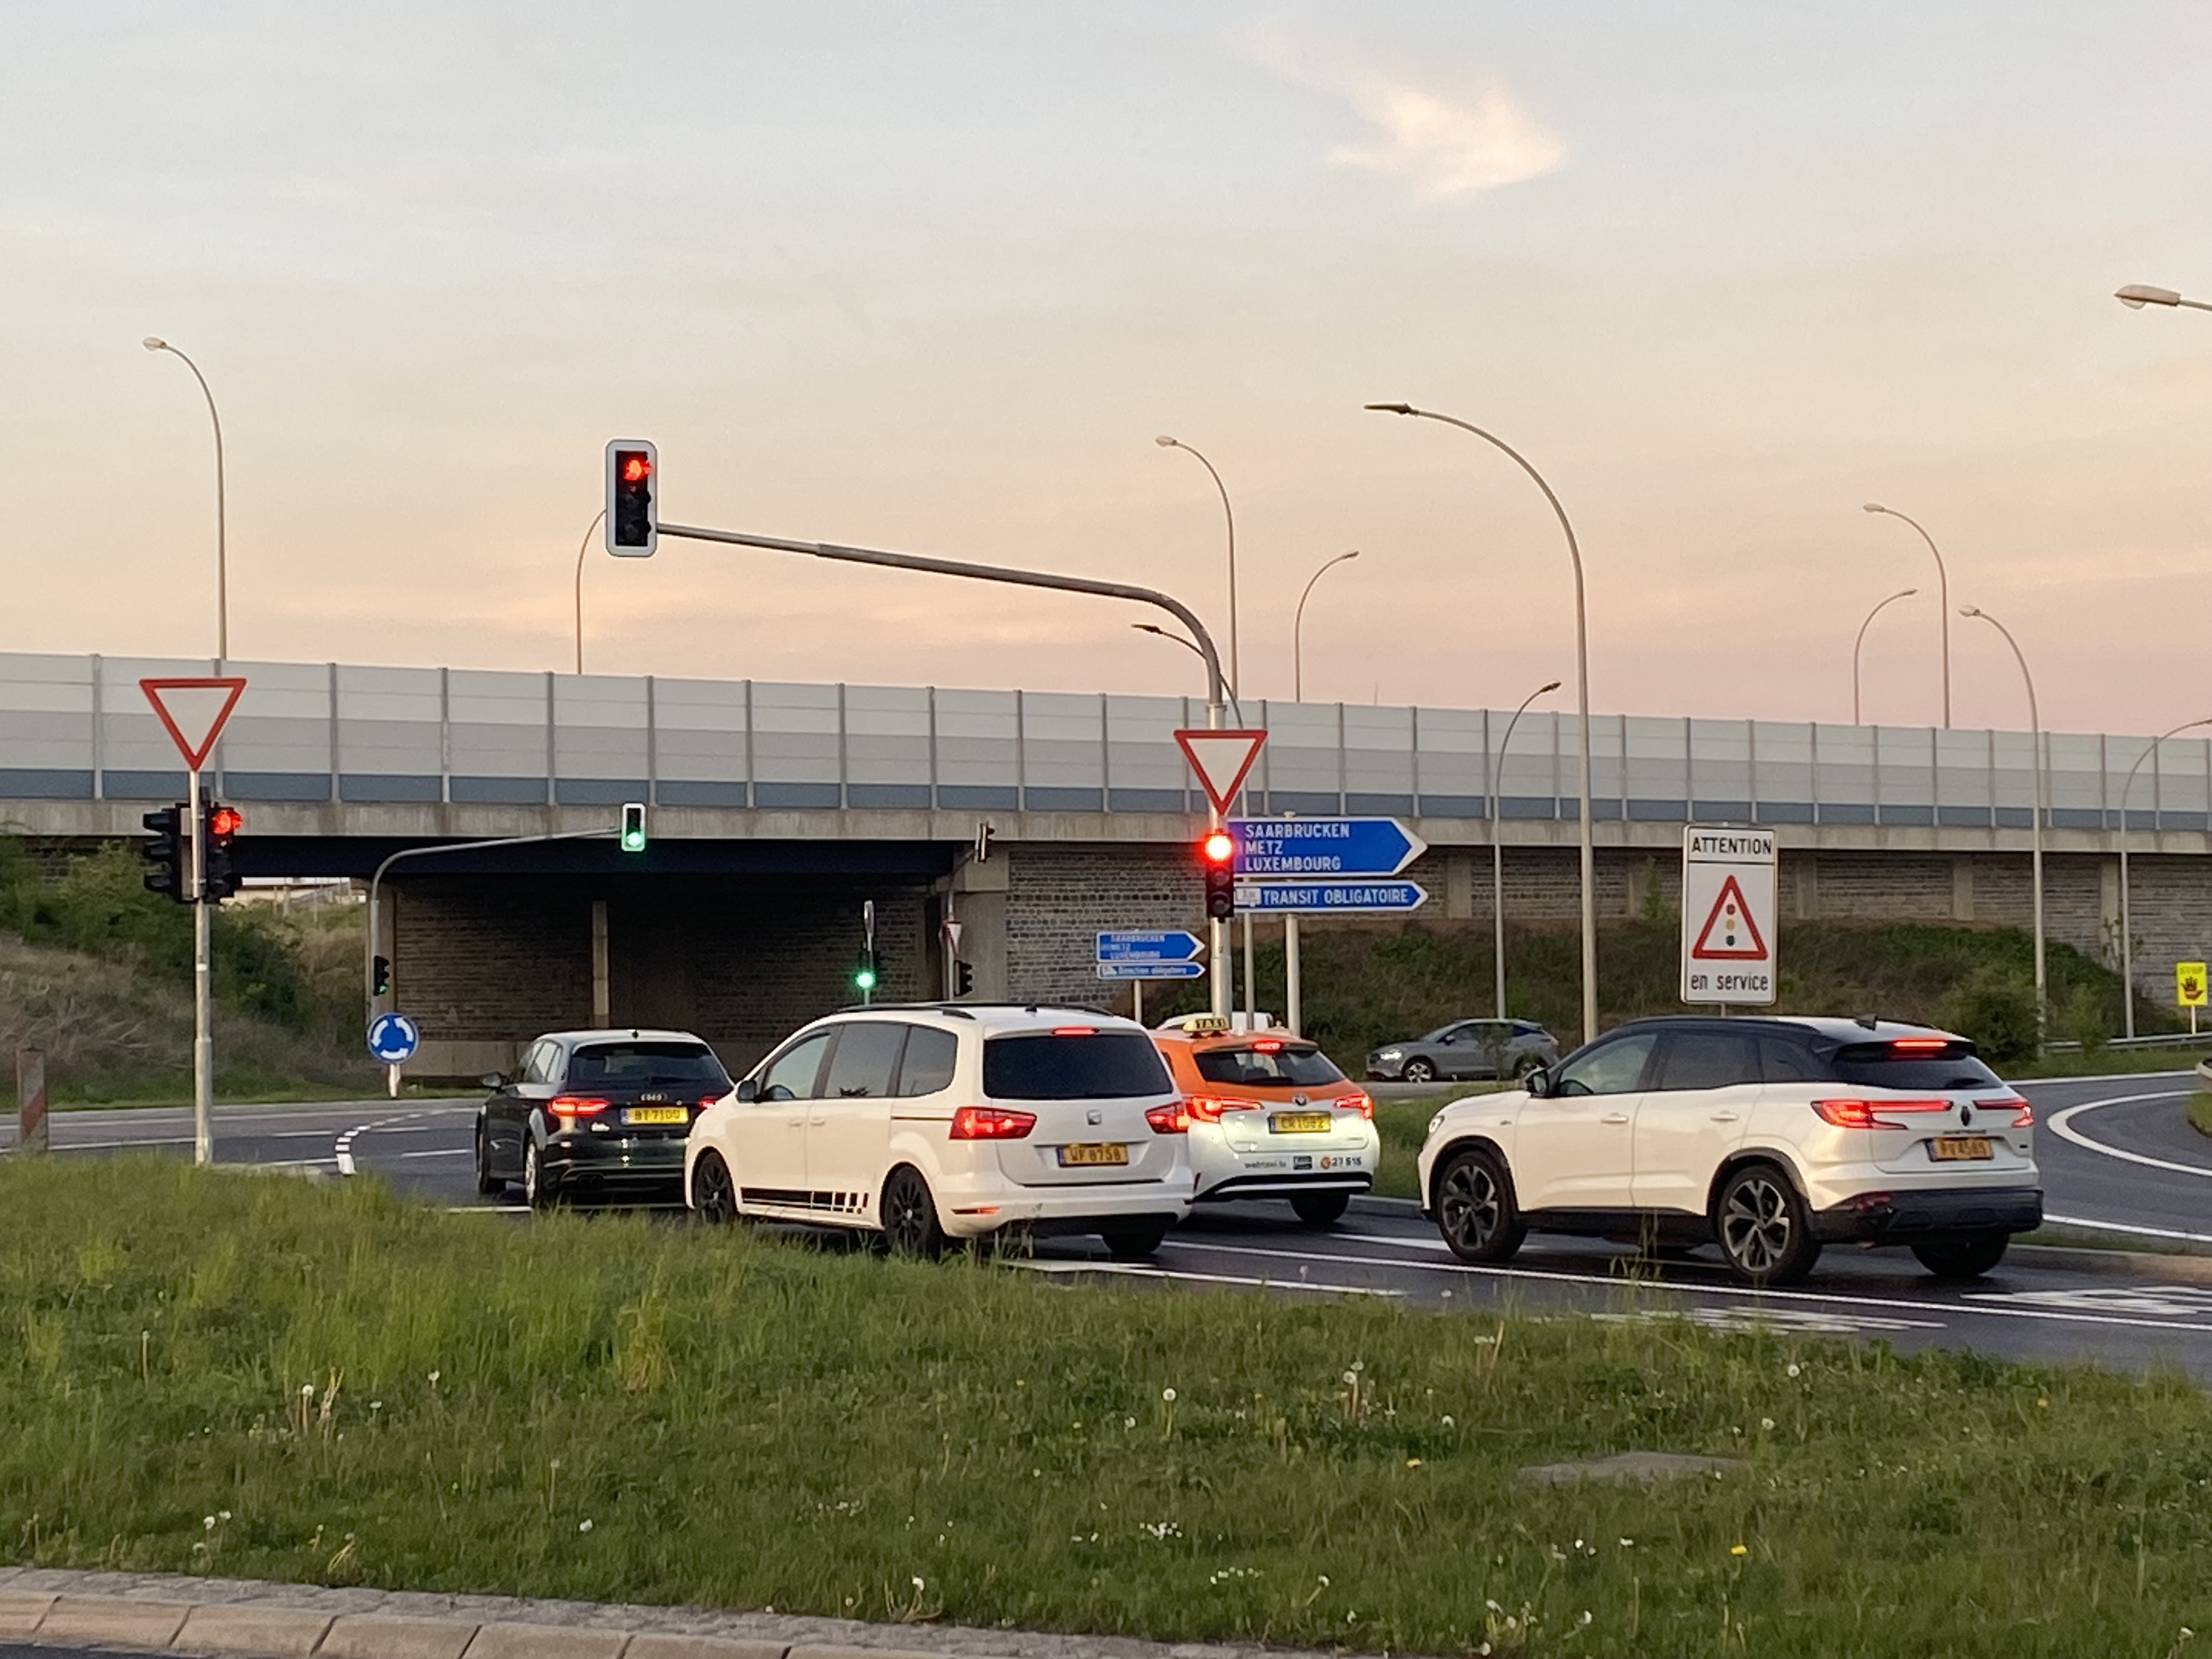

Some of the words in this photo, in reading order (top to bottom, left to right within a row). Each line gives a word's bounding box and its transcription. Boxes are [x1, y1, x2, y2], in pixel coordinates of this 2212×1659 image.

[1245, 840, 1283, 855] METZ
[1692, 837, 1772, 854] ATTENTION
[1245, 856, 1341, 871] LUXEMBOURG
[1263, 889, 1318, 905] TRANSIT
[1323, 888, 1409, 904] OBLIGATOIRE
[1691, 974, 1708, 990] en
[1716, 973, 1768, 991] service
[1195, 1018, 1226, 1029] TAXI
